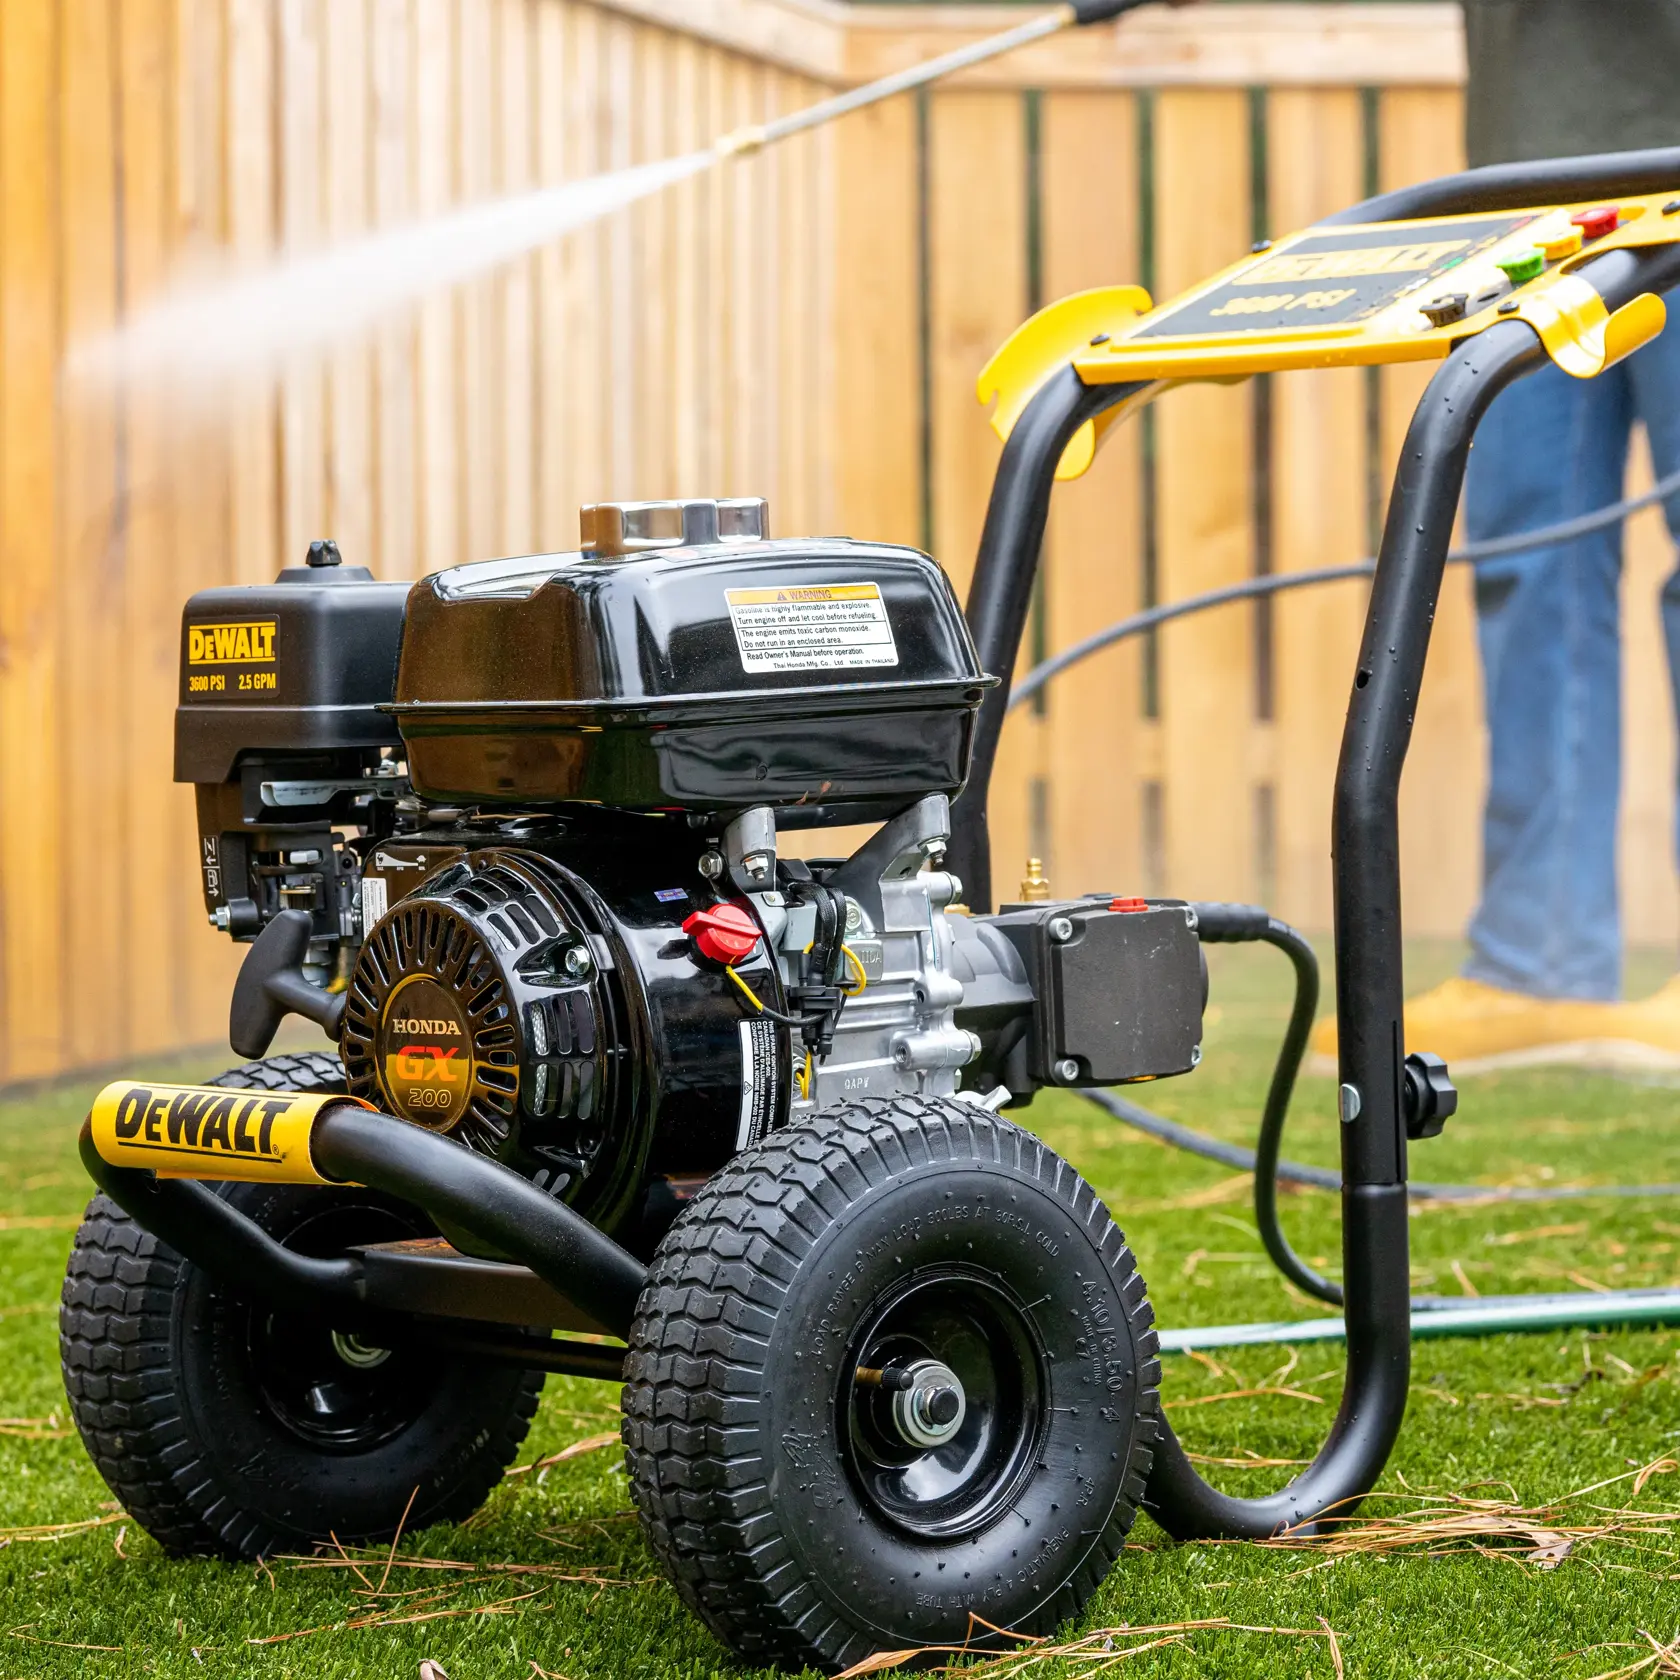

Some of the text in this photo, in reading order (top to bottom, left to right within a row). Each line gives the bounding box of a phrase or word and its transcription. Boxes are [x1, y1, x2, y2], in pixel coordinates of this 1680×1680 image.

[789, 590, 832, 600] WARNING
[772, 605, 790, 613] highly
[792, 603, 826, 611] flammable
[841, 602, 872, 610] explosive.
[738, 617, 753, 625] Turn
[754, 617, 776, 625] engine
[811, 613, 825, 621] cool
[826, 612, 847, 620] before
[849, 611, 878, 620] refueling.
[741, 629, 754, 637] The
[755, 629, 777, 637] engine
[779, 627, 796, 635] emits
[797, 627, 813, 635] toxic
[815, 626, 837, 634] carbon
[189, 626, 276, 661] DEWALT
[779, 638, 786, 646] in
[797, 637, 825, 645] enclosed
[747, 647, 864, 660] Read Owner's Manual before operation.
[189, 673, 276, 691] 3600 PSI 2.5 GPM
[393, 1019, 462, 1035] HONDA
[757, 1021, 763, 1030] CE
[751, 1021, 759, 1054] CONFORME
[762, 1021, 770, 1050] CANADIAN
[396, 1046, 459, 1081] GX
[754, 1061, 760, 1070] LA
[408, 1088, 451, 1108] 200
[115, 1088, 293, 1155] DEWALT
[751, 1116, 757, 1125] DU
[767, 1105, 775, 1133] COMPLIES
[811, 1319, 830, 1356] LOAD
[827, 1272, 856, 1315] RANGE
[866, 1235, 891, 1262] MAX
[892, 1217, 921, 1241] LOAD
[927, 1205, 969, 1224] 300LBS
[975, 1206, 991, 1218] AT
[1035, 1231, 1060, 1257] COLD
[1081, 1315, 1101, 1386] MADE IN CHINA
[1017, 1525, 1070, 1582] PNEUMATIC
[916, 1592, 943, 1609] TUBE
[948, 1593, 975, 1608] WITH
[982, 1584, 1002, 1602] PLY
